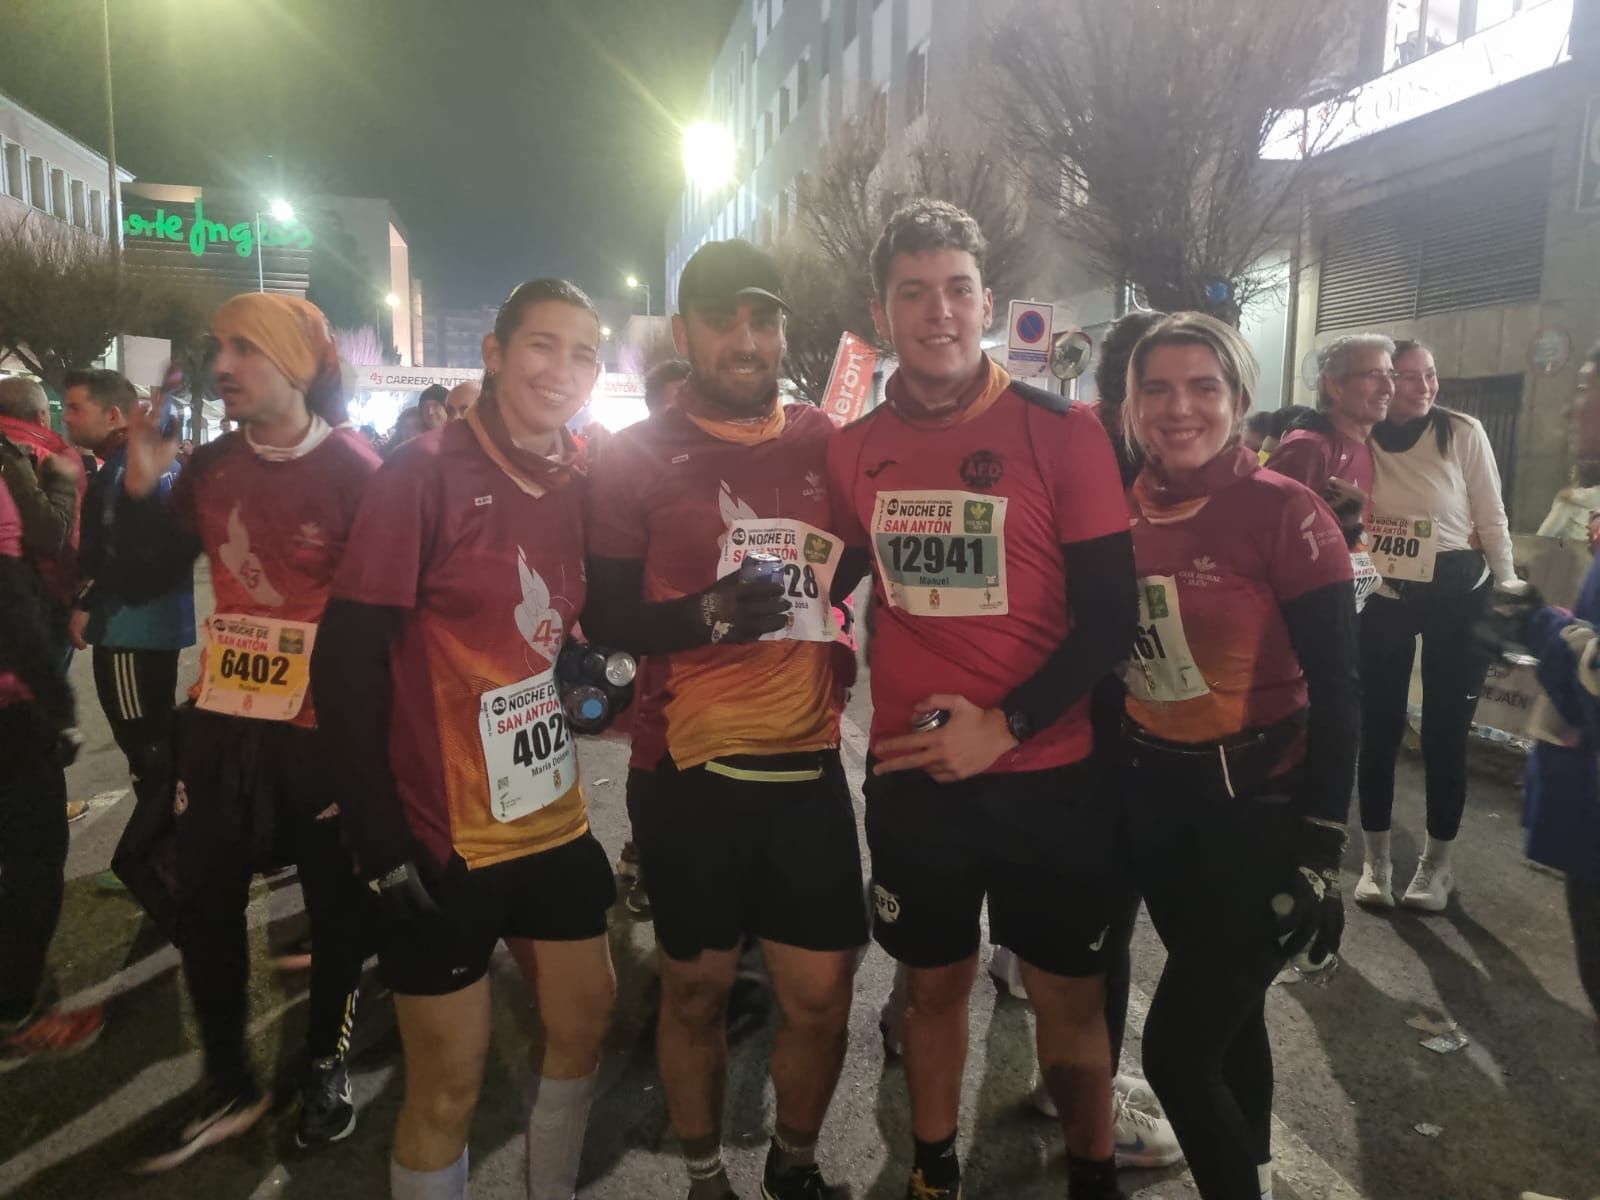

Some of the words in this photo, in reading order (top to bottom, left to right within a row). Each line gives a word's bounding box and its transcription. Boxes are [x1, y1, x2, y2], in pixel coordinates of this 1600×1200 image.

[123, 208, 184, 241] orte
[386, 375, 434, 386] CARRERA
[900, 504, 935, 517] NOCHE
[937, 505, 952, 518] DE
[884, 519, 907, 532] SAN
[911, 517, 952, 534] ANTÓN
[748, 532, 782, 545] NOCHE
[784, 533, 797, 545] DE
[1372, 535, 1420, 558] 7480
[888, 536, 984, 575] 12941
[783, 563, 819, 599] 28
[919, 575, 950, 586] Manuel
[217, 634, 235, 646] SAN
[228, 625, 255, 637] NOCHE
[256, 628, 269, 639] DE
[220, 648, 290, 686] 6402
[508, 688, 546, 712] NOCHE
[497, 715, 523, 735] SAN
[512, 712, 570, 768] 402
